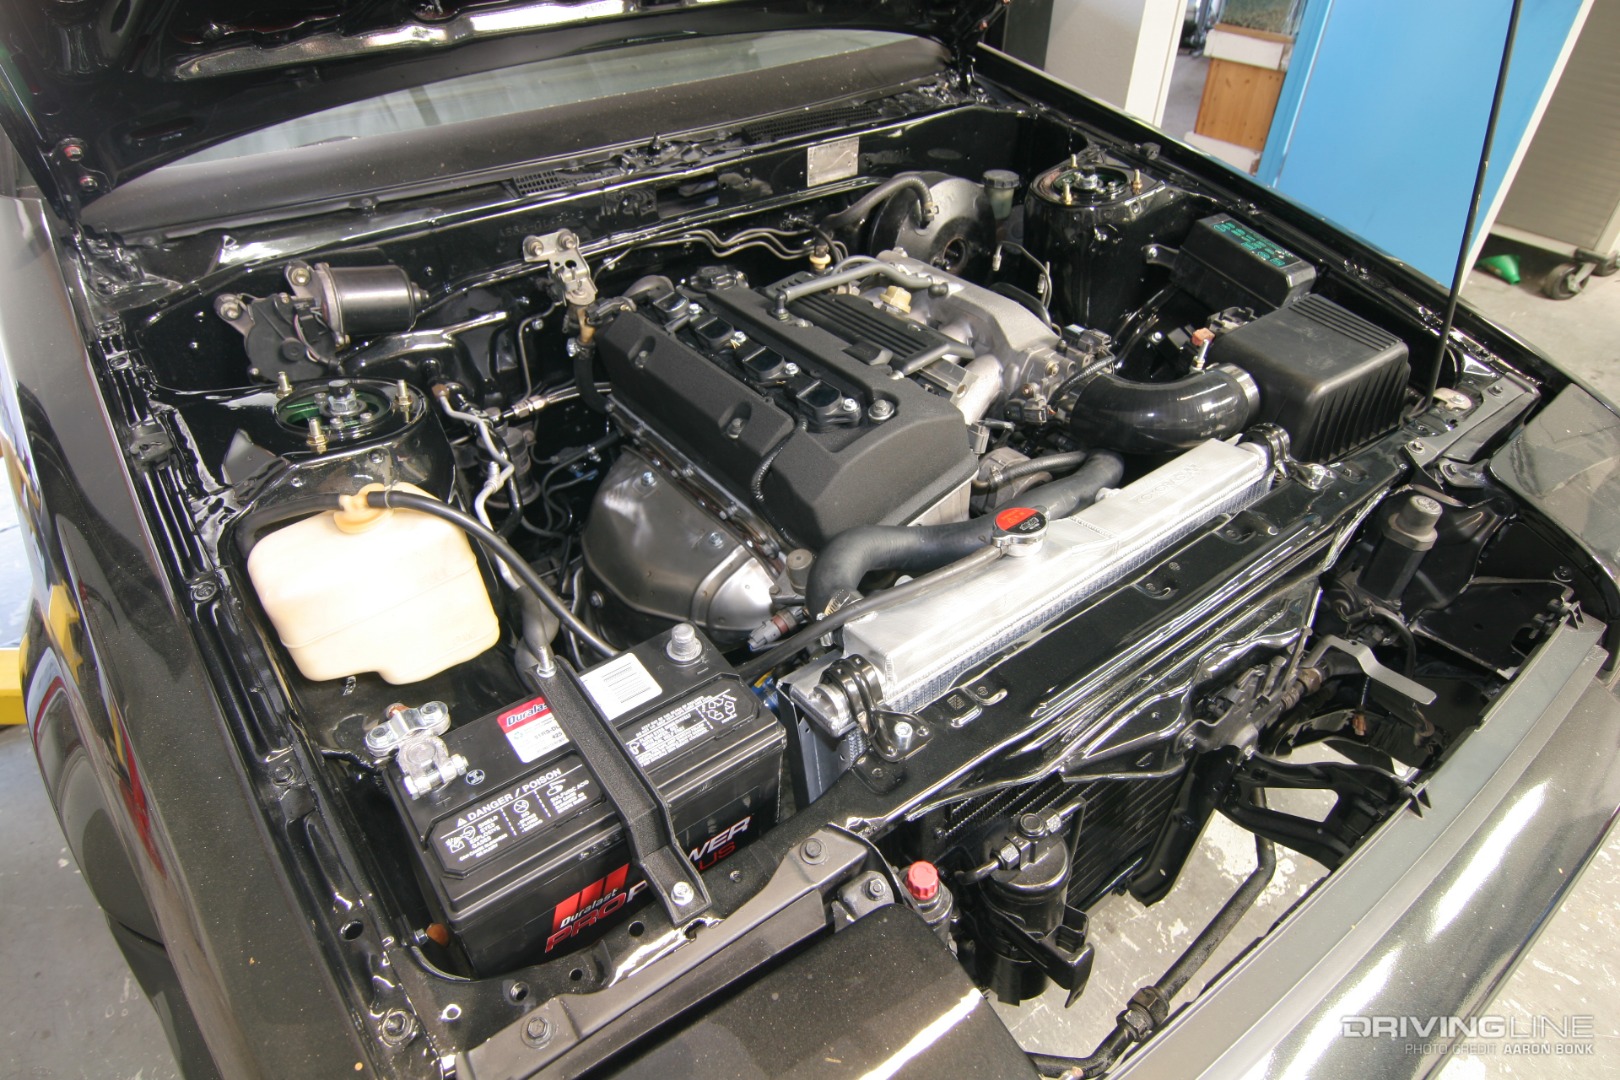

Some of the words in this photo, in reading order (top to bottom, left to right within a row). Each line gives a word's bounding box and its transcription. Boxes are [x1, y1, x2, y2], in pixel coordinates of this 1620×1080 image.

[506, 702, 548, 727] Durala
[467, 794, 513, 820] DANGER
[522, 768, 562, 792] POISON
[560, 888, 618, 928] Duralast
